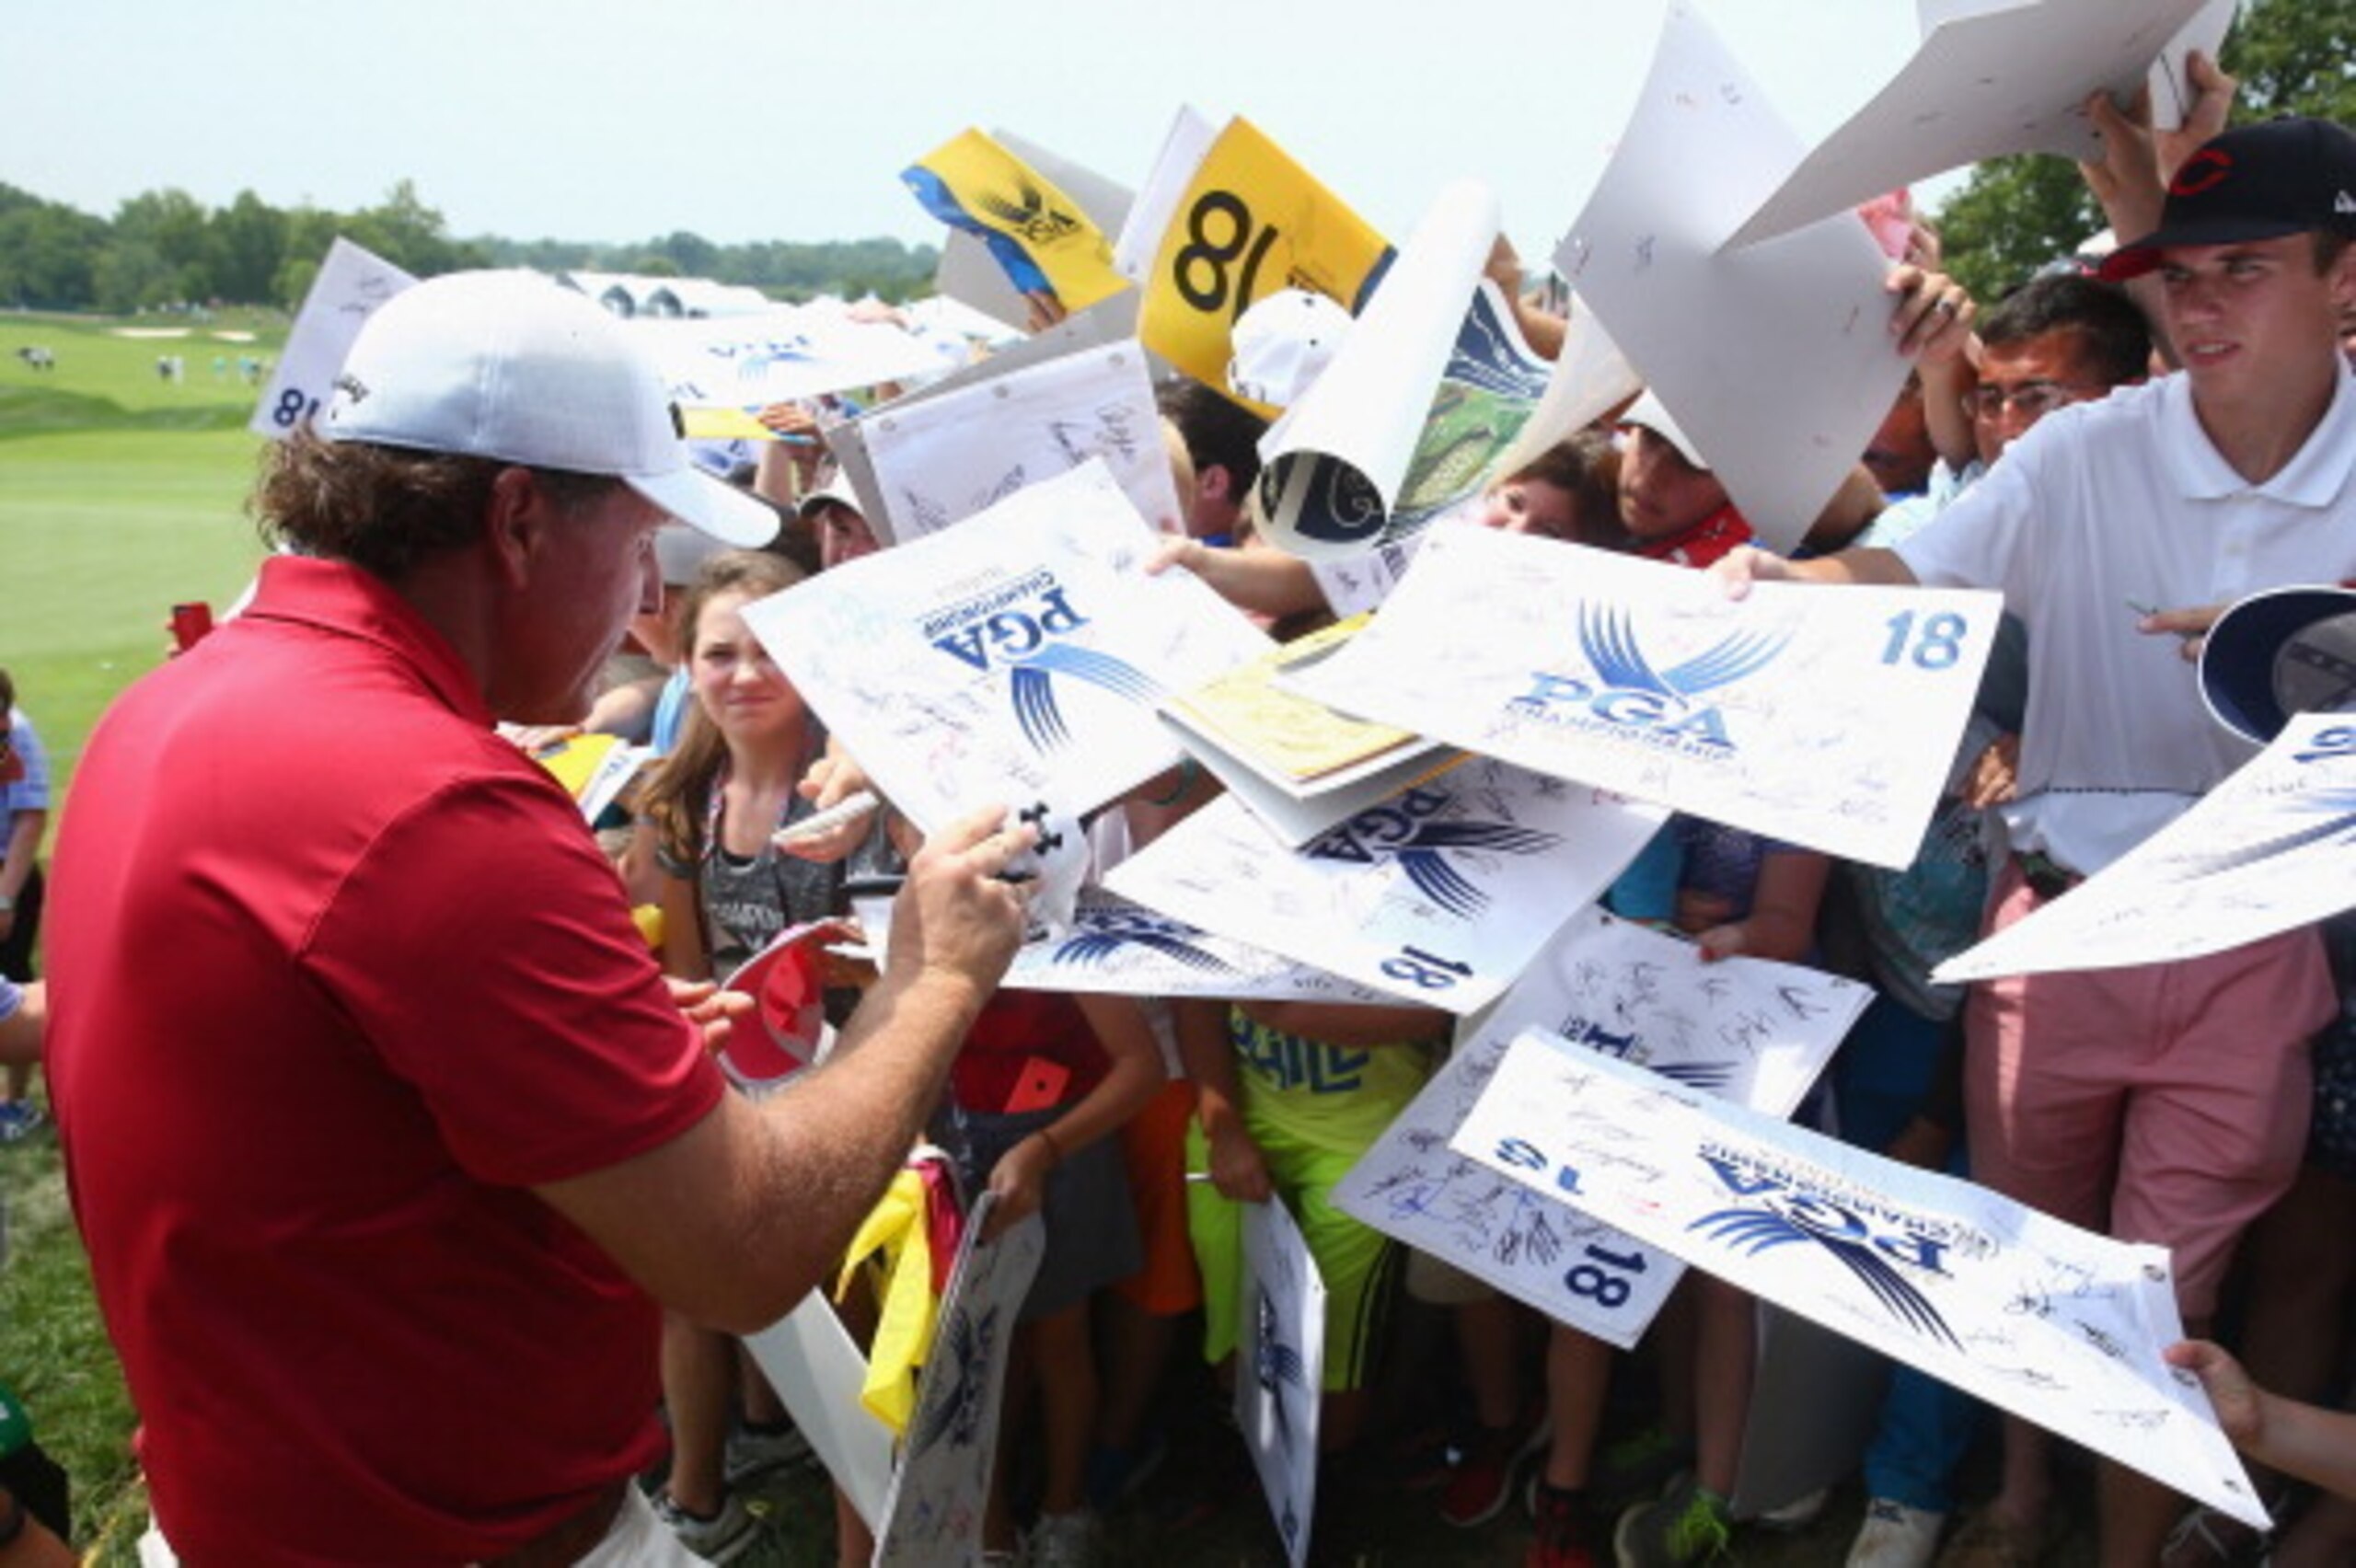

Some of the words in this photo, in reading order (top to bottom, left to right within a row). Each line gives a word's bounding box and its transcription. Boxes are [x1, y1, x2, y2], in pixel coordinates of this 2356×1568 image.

[931, 584, 1091, 672] PGA
[1880, 608, 1968, 670] 18
[1512, 670, 1738, 751] PGA
[1380, 944, 1474, 989] 18
[1701, 1157, 1955, 1280] PGA
[1564, 1243, 1649, 1308] 18
